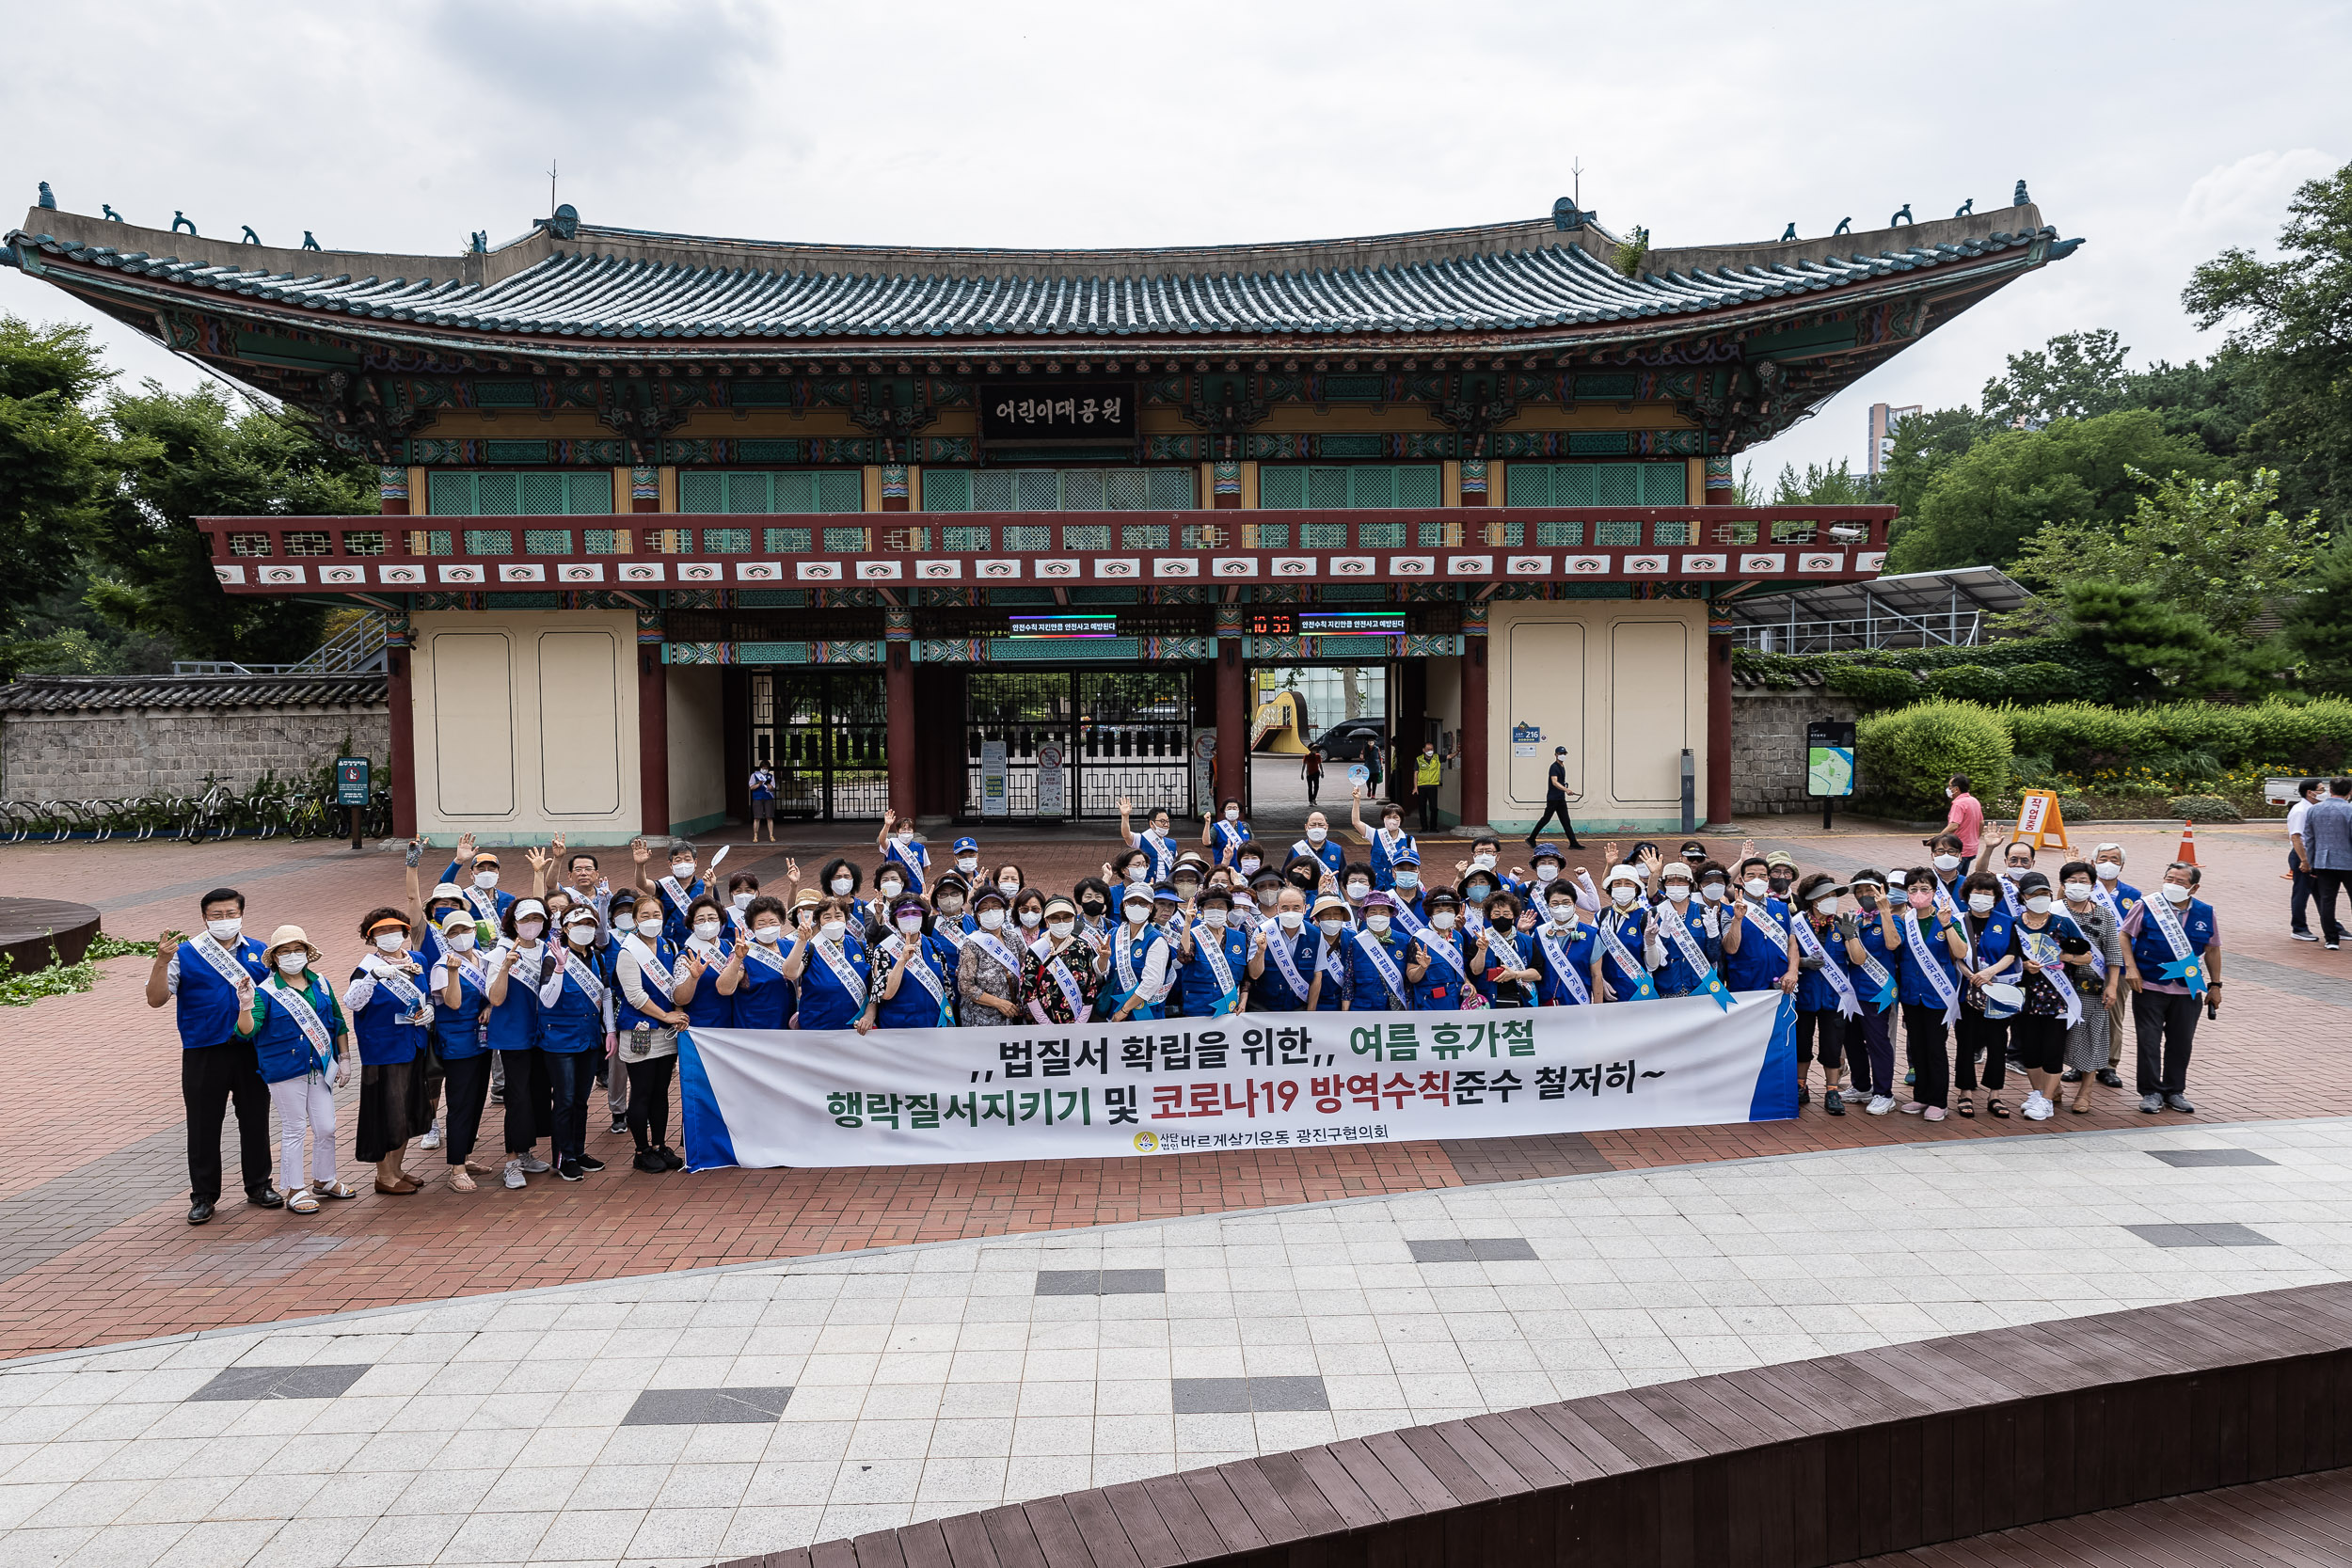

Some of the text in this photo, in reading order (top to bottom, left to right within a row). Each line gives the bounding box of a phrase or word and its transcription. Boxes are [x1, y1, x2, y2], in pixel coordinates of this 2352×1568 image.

[995, 397, 1121, 424] 어린이대공원
[1012, 622, 1116, 631] 안전수칙 지킨만큼 안전사고 예방된다
[1301, 621, 1327, 629] 안전수칙
[1354, 620, 1379, 628] 안전사고
[1379, 620, 1405, 628] 예방된다
[2026, 798, 2042, 832] 작업중
[199, 946, 234, 979] 마스크착용
[644, 963, 665, 988] 코로나19
[649, 958, 666, 977] 여름철
[1548, 942, 1587, 1003] 바르게살기운동
[569, 967, 597, 998] 마스크착용
[1830, 971, 1844, 986] 지키기
[274, 991, 308, 1025] 마스크착용
[1120, 1031, 1230, 1073] 확립을
[1350, 1022, 1420, 1062] 여름
[1431, 1019, 1536, 1061] 휴가철
[827, 1059, 1667, 1131] 행락질서지키기 및 코로나19 방역수칙준수 철저히~
[1160, 1133, 1180, 1142] 사단
[1181, 1124, 1389, 1148] 바르게살기운동 광진구협의회
